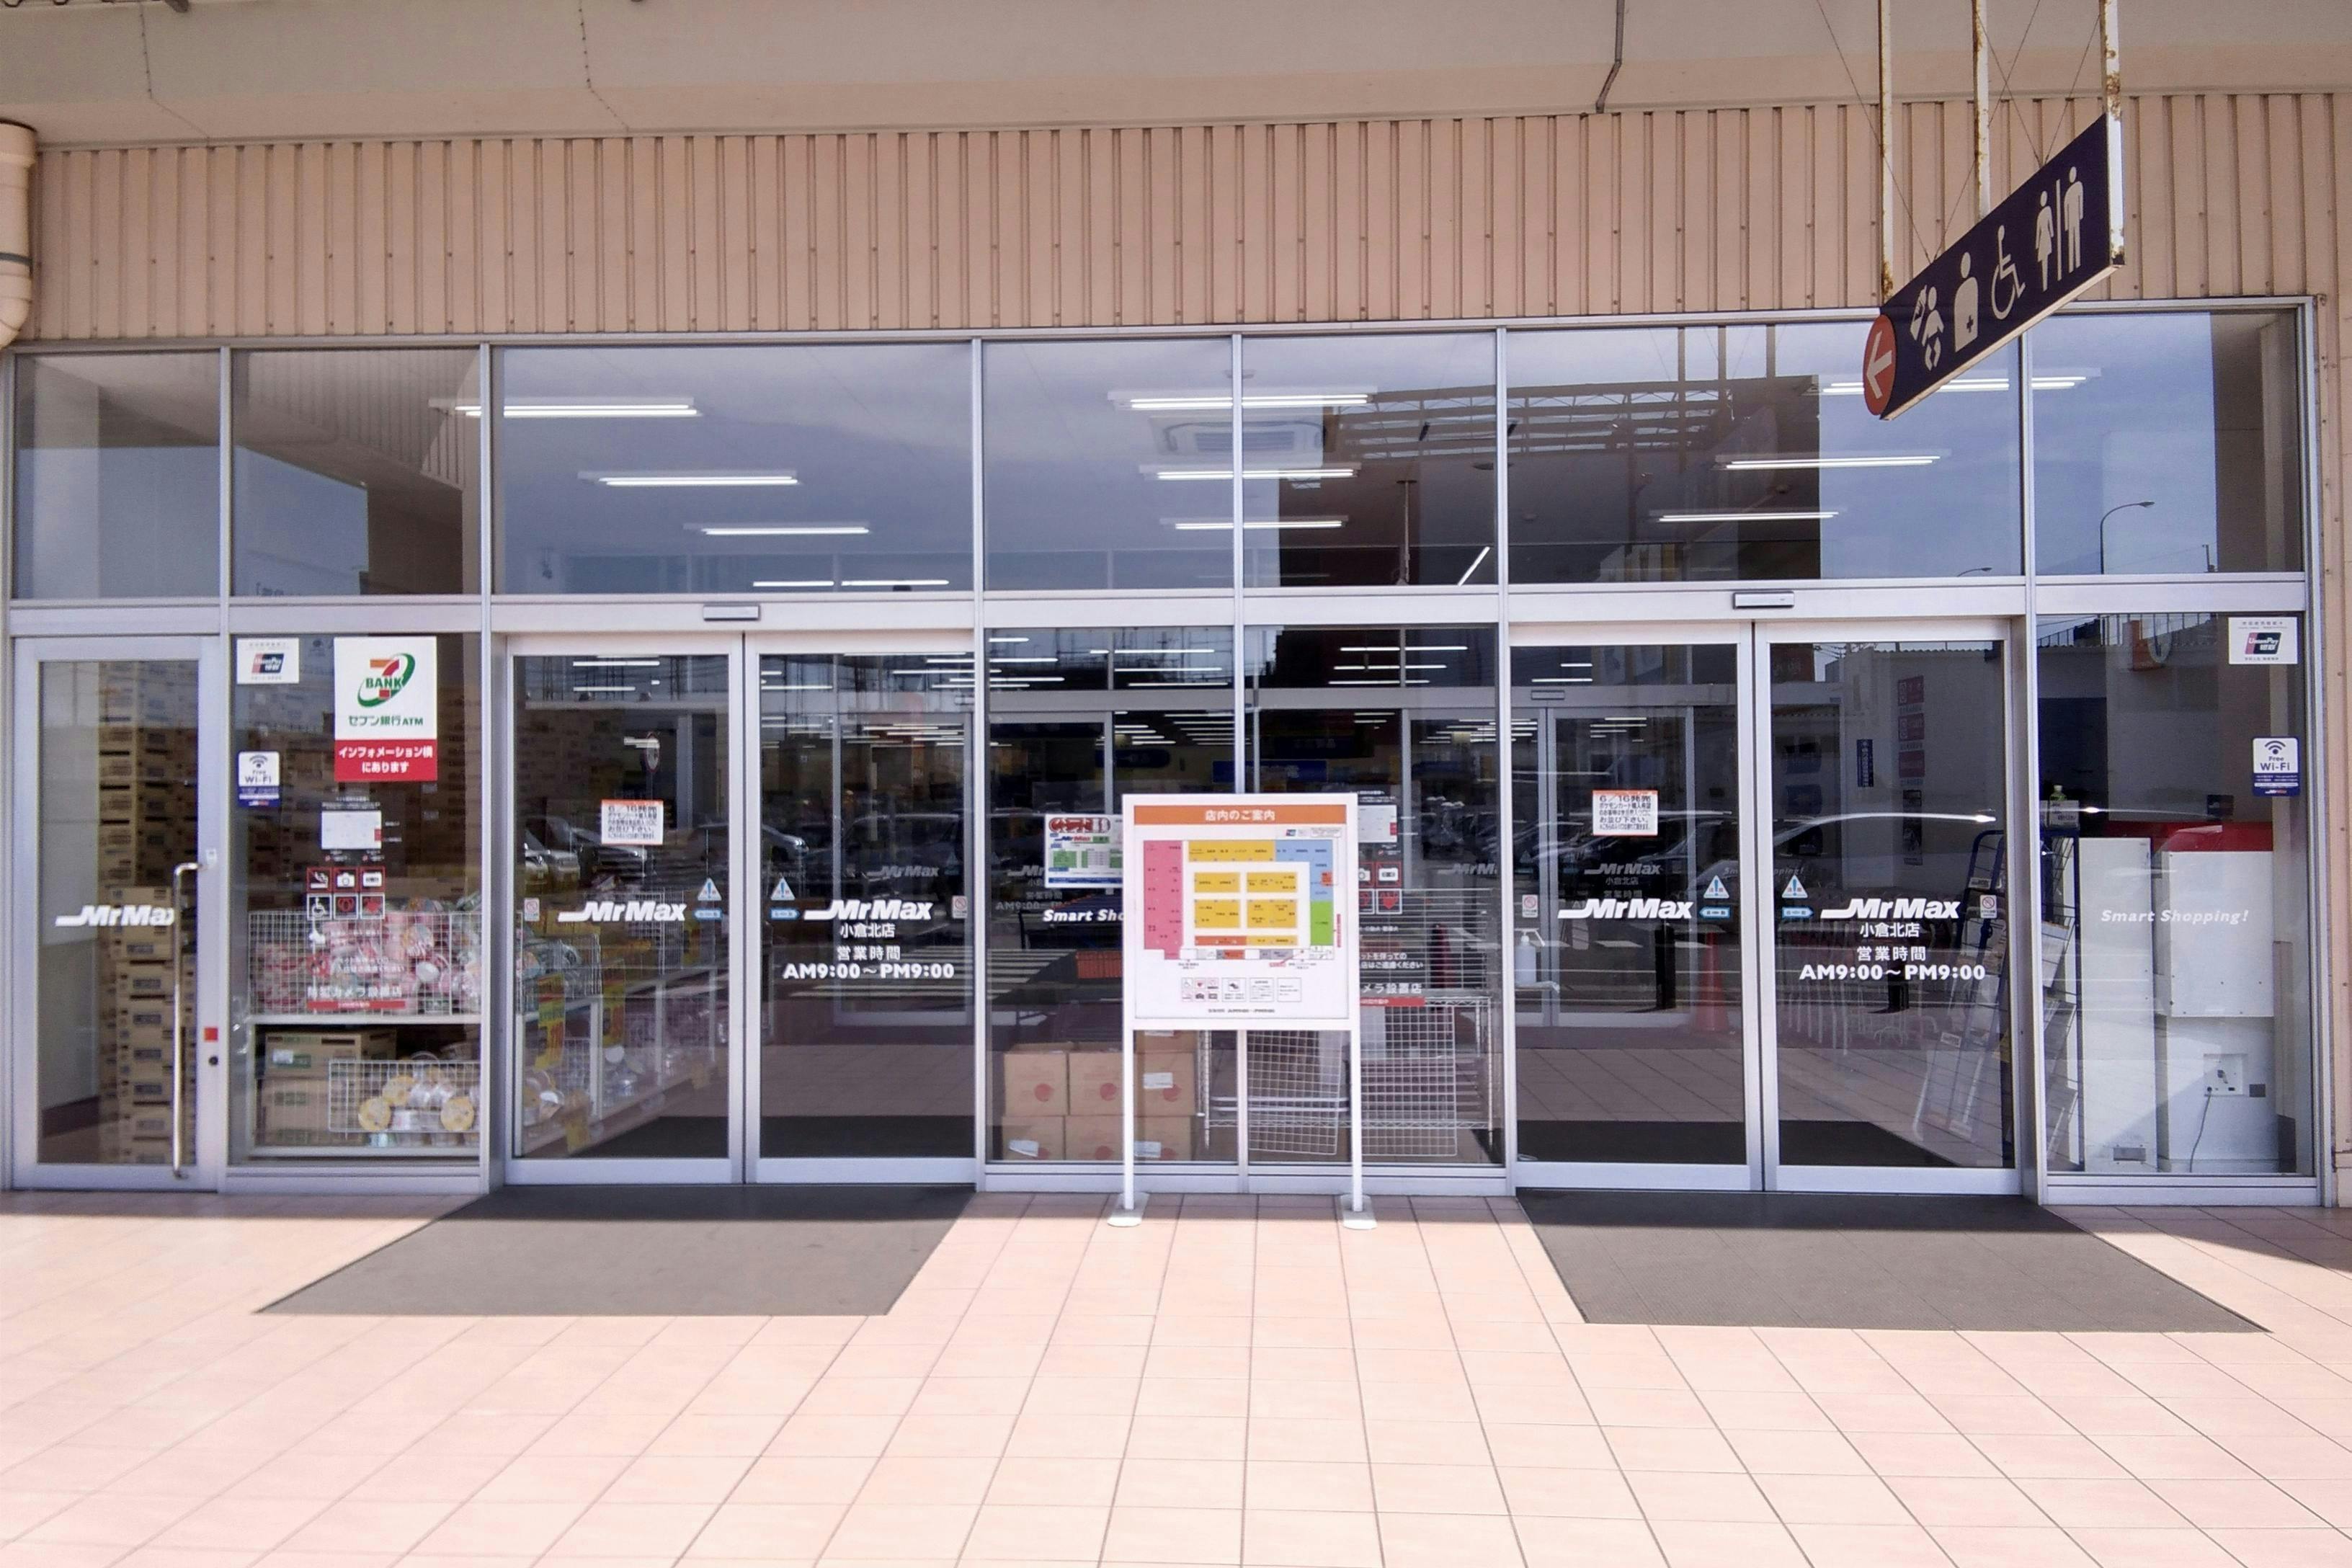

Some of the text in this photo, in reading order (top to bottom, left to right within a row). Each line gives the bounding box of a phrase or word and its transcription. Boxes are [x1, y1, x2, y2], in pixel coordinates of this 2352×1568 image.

[365, 678, 402, 690] BANK
[339, 745, 433, 759] インフォメーション横
[362, 761, 409, 773] にあります
[2260, 762, 2290, 771] Wi-Fi
[1204, 809, 1276, 821] 店内のご案内
[866, 865, 940, 878] MrMax
[1584, 863, 1661, 875] MrMax
[557, 901, 687, 922] MrMax
[803, 899, 934, 921] MrMax
[1043, 908, 1093, 922] Smart
[1557, 898, 1694, 919] MrMax
[1820, 898, 1961, 919] MrMax
[2101, 909, 2249, 925] Smart Shopping!
[840, 922, 896, 938] 小倉北店
[1859, 922, 1920, 937] 小倉北店
[837, 945, 901, 961] 営業時間
[1857, 946, 1926, 961] 営業時間
